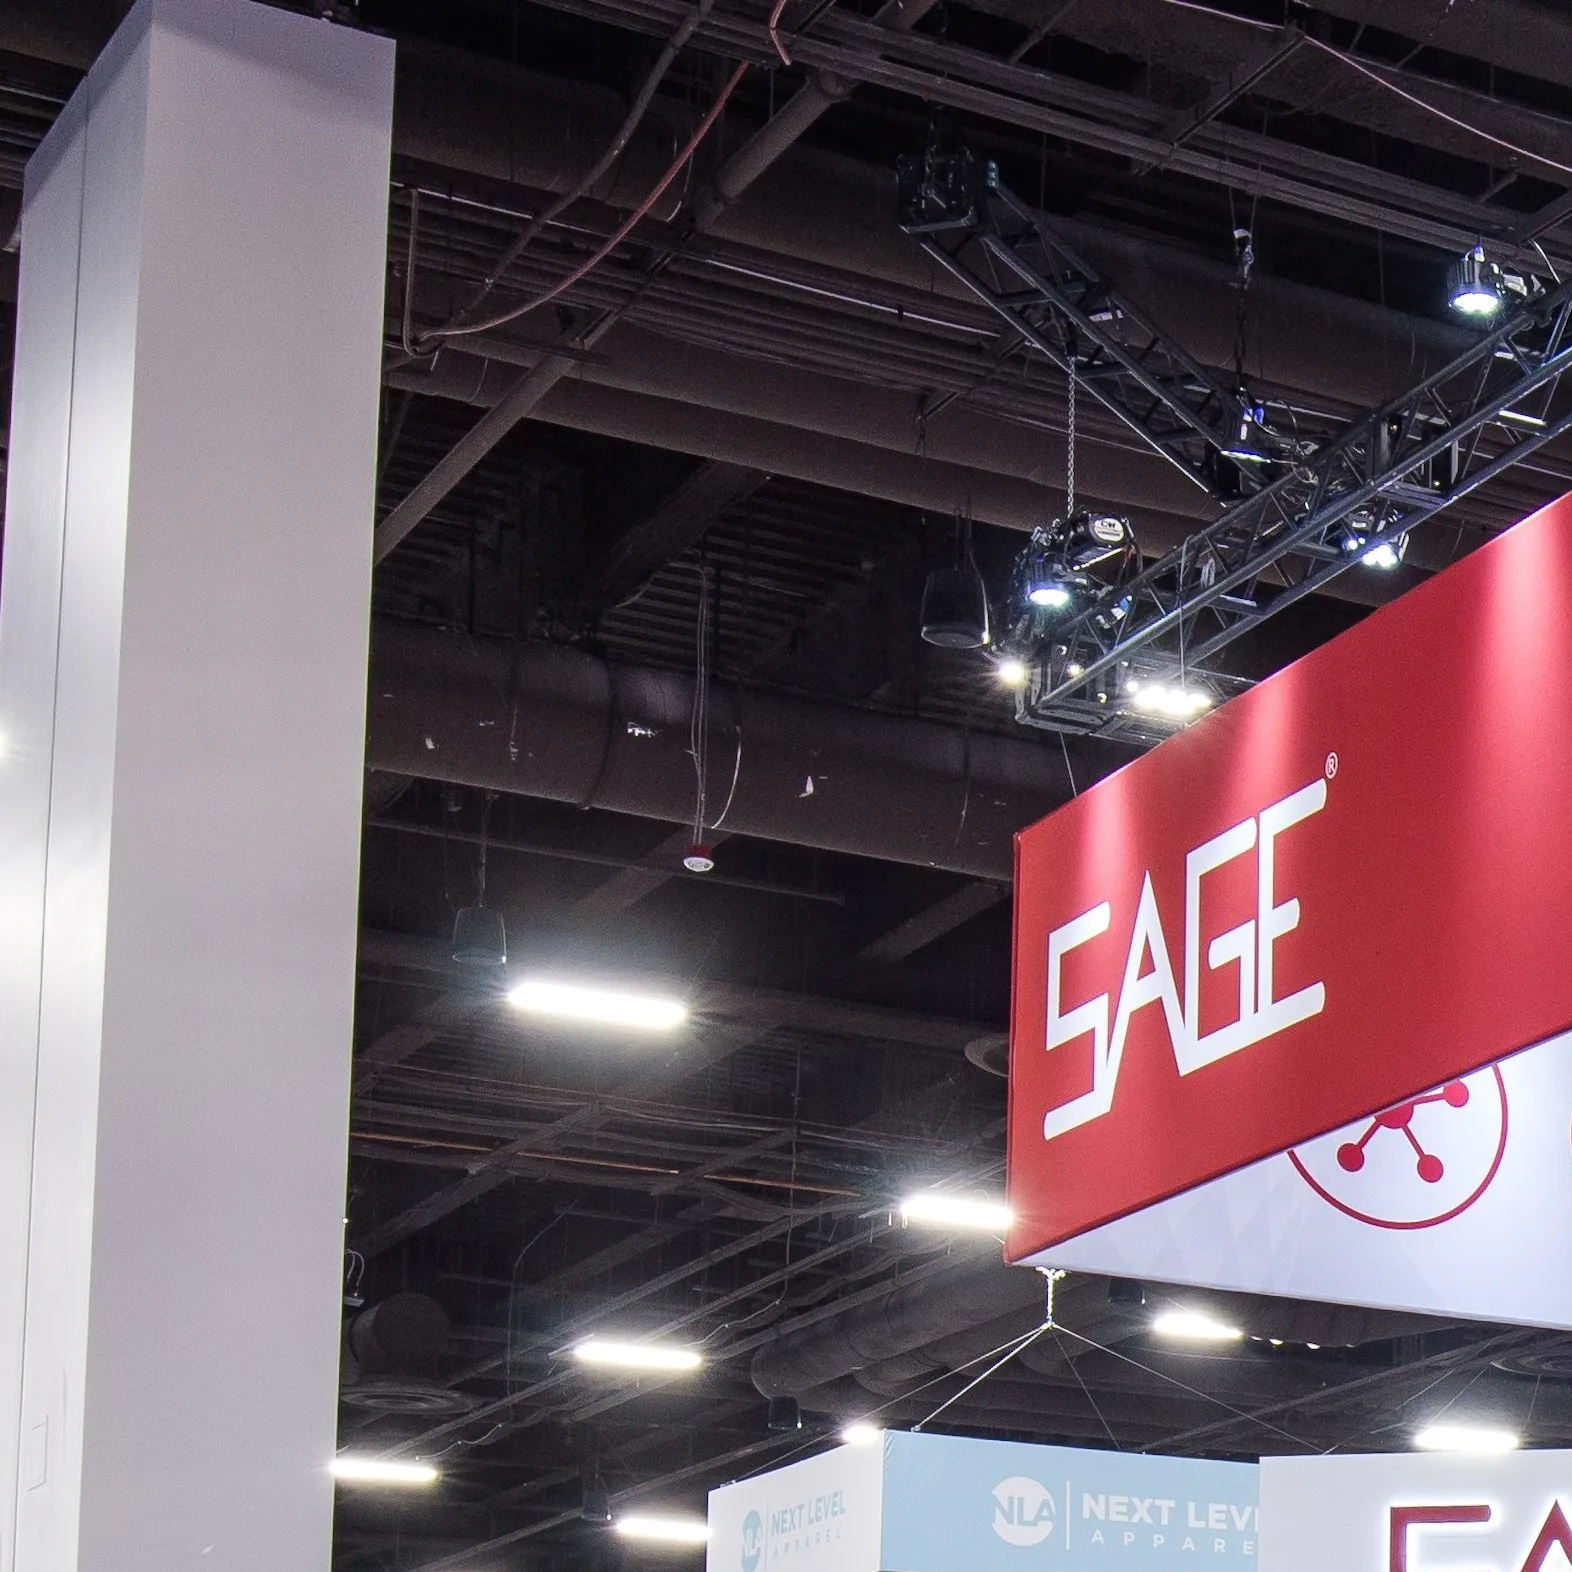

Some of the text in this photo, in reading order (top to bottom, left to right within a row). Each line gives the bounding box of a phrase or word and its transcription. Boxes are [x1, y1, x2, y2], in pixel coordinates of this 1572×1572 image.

[771, 1502, 804, 1537] NEXT
[807, 1489, 846, 1525] LEVEL
[1081, 1492, 1176, 1526] NEXT
[1187, 1501, 1258, 1532] LEV
[773, 1527, 842, 1560] APPAREL
